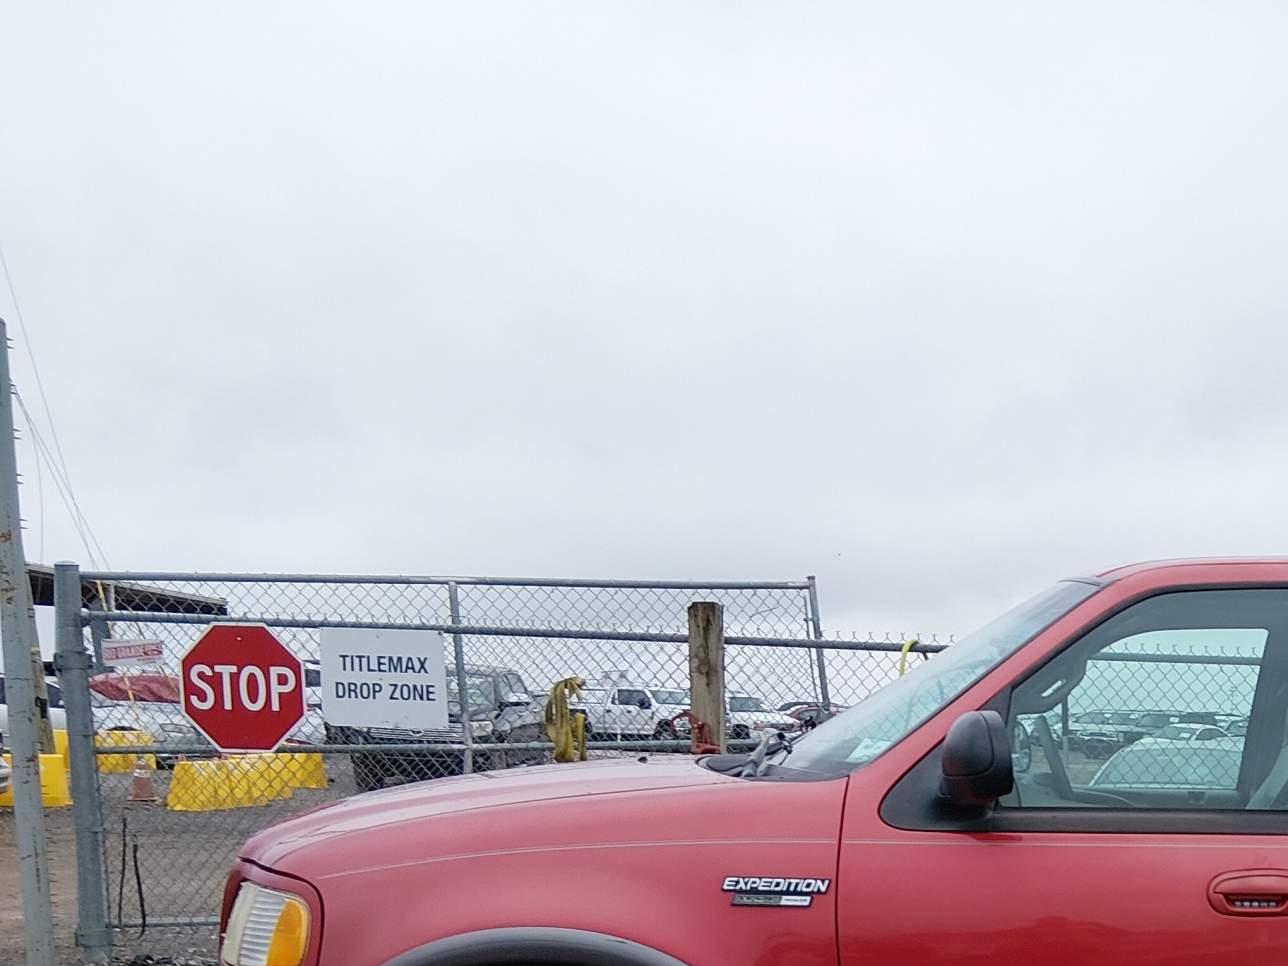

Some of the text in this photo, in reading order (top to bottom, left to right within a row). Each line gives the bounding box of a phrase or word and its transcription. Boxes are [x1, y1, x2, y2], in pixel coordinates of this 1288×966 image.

[340, 654, 430, 675] TITLEMAX
[189, 664, 296, 711] STOP
[335, 681, 437, 702] DROP ZONE
[722, 877, 829, 892] EXPEDITION
